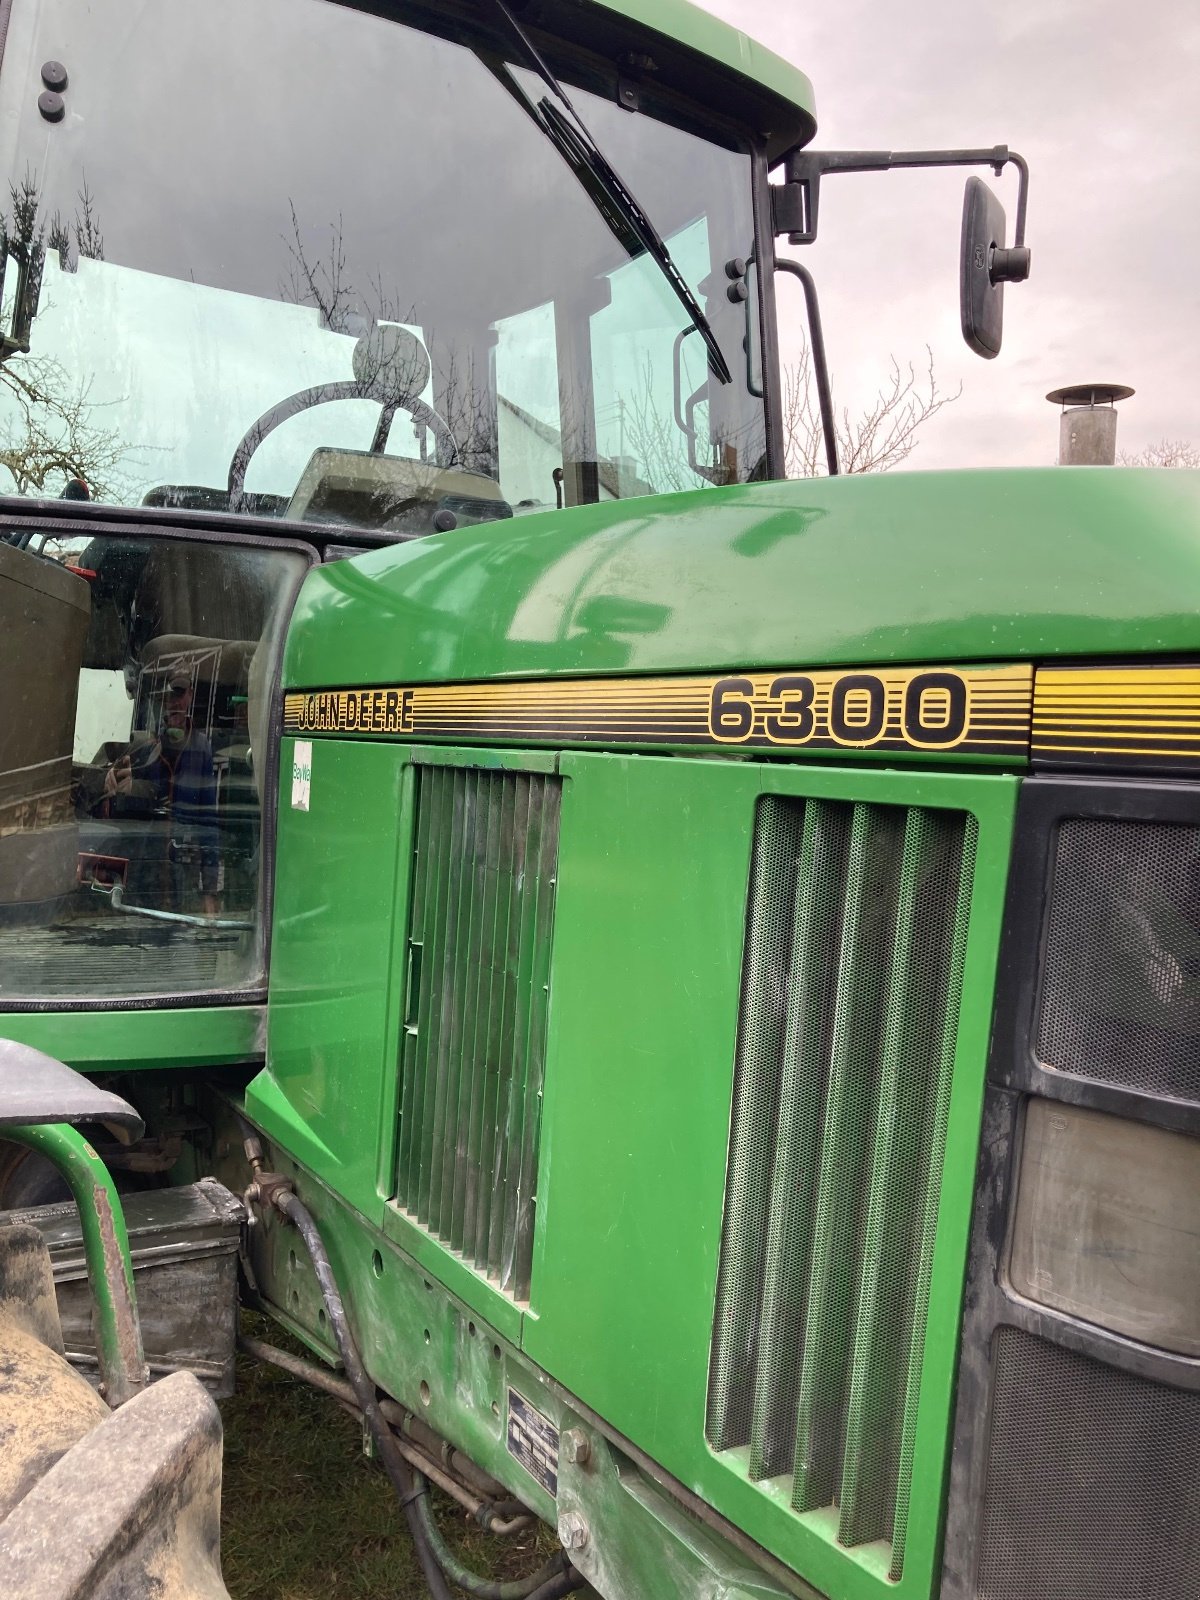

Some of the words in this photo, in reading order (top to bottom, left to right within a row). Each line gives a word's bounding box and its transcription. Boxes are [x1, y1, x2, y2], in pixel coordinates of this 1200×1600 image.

[298, 694, 340, 730] JOHN
[345, 690, 415, 732] DEERE
[709, 672, 968, 748] 6300
